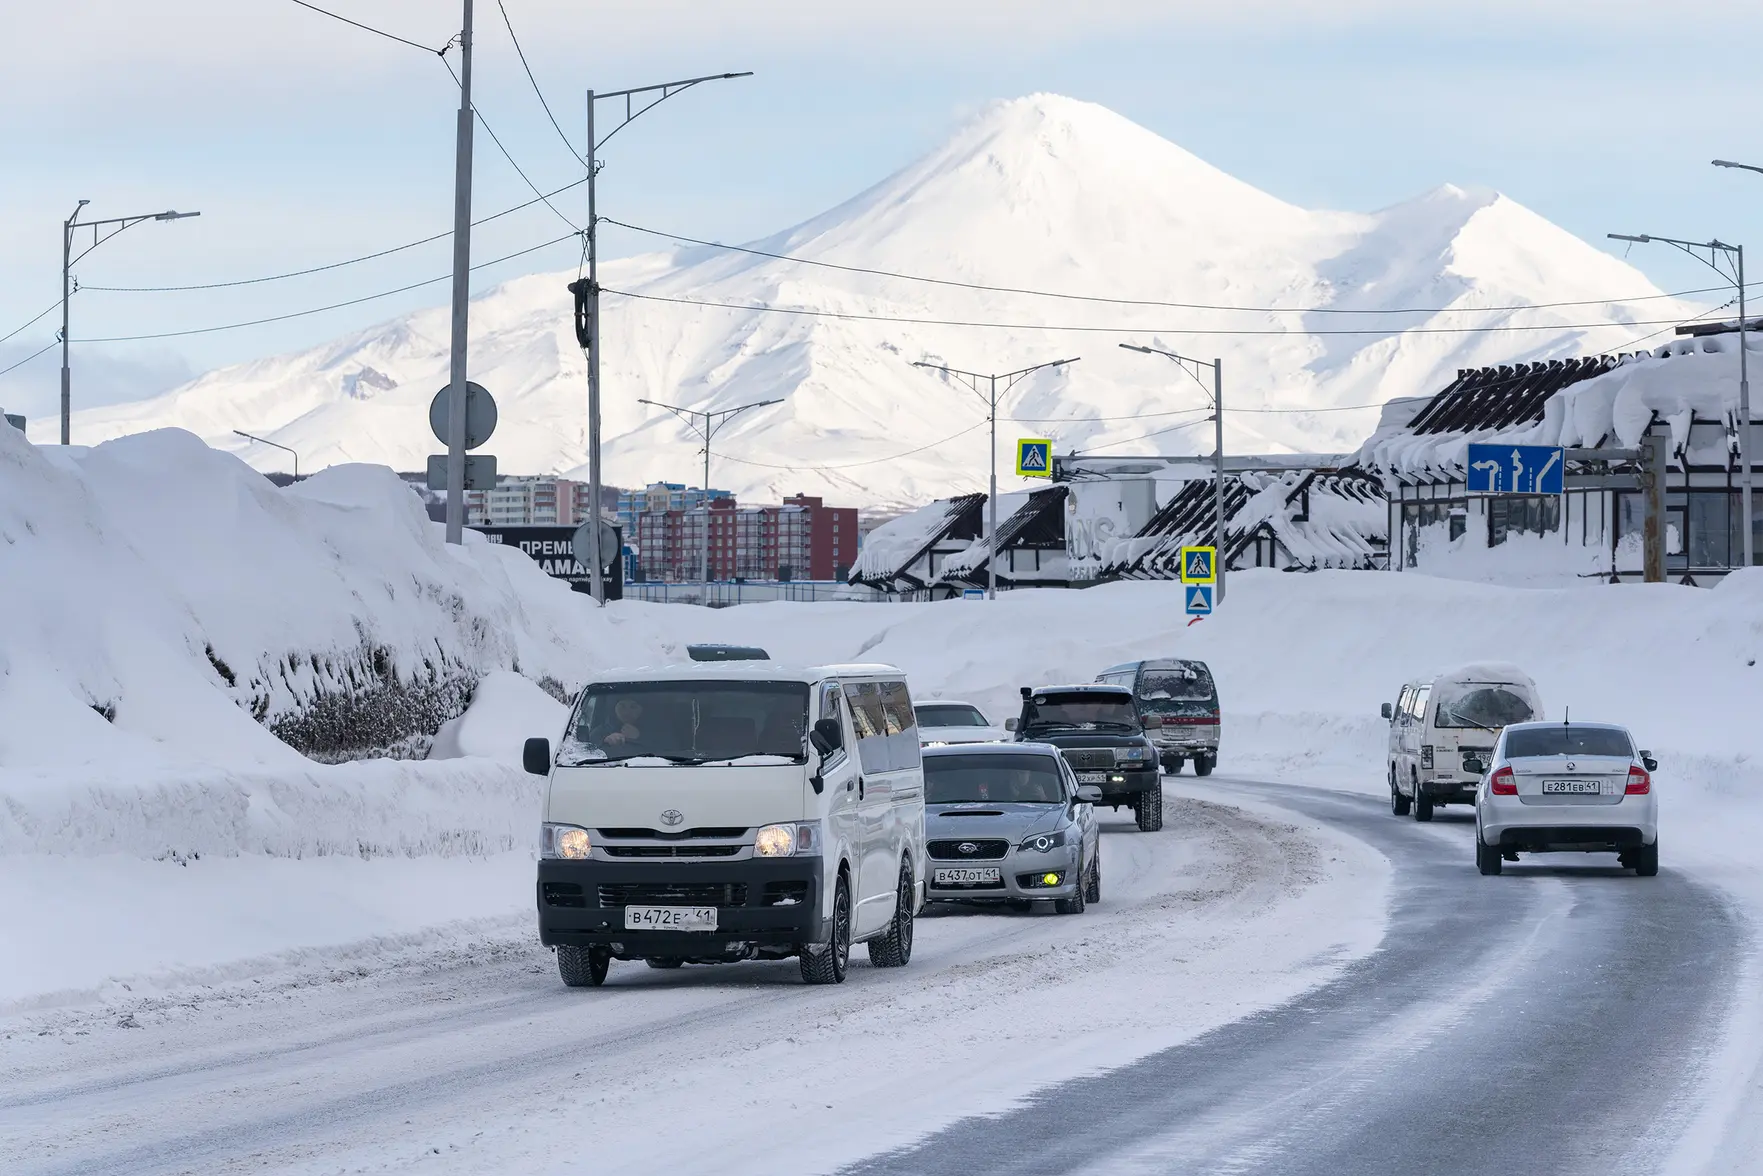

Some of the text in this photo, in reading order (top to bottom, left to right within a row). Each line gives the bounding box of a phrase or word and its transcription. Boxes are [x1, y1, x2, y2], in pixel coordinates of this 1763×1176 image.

[1547, 783, 1584, 792] Е281ЕВ
[940, 868, 996, 881] В437ОТ 41
[633, 909, 688, 925] В472Е
